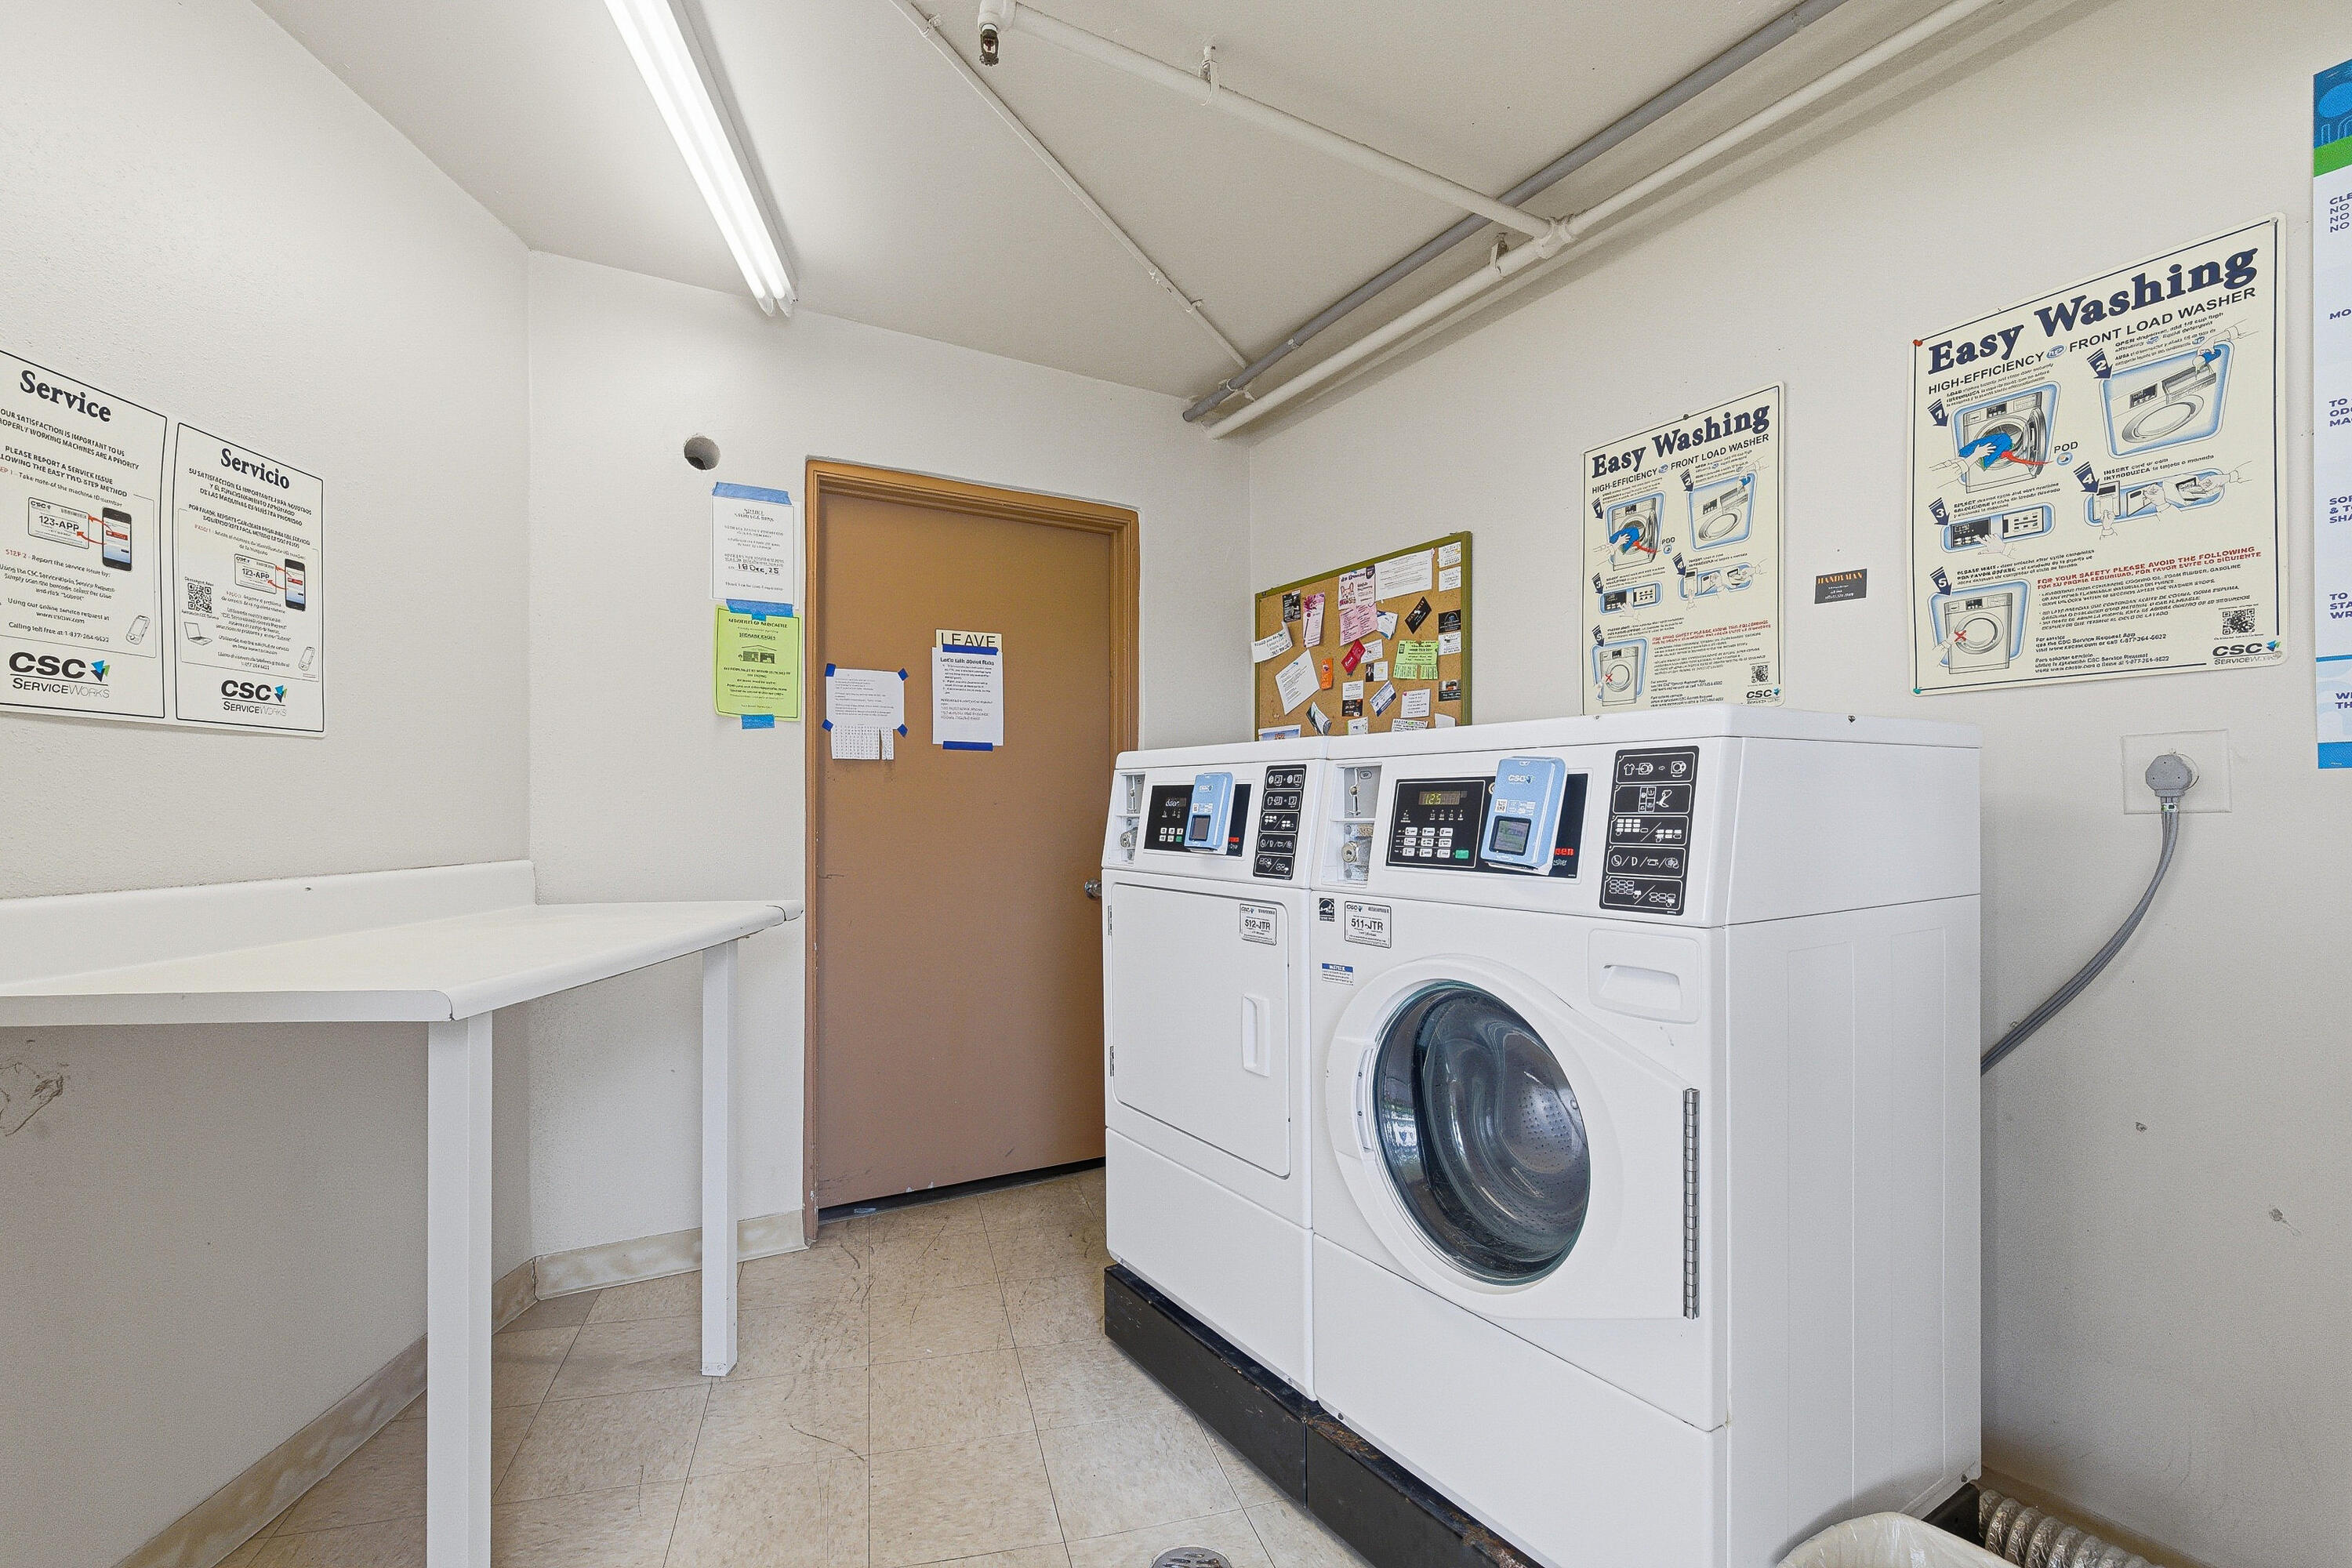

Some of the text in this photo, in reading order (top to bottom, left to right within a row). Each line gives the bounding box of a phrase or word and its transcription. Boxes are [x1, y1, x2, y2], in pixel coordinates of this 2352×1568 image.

[2330, 204, 2349, 213] NO
[2330, 213, 2349, 223] NO
[2330, 222, 2349, 232] NO
[1928, 248, 2258, 374] Easy Washing
[1929, 288, 2256, 394] HIGH-EFFICIENCY FRONT LOAD WASHER
[20, 370, 111, 422] Service
[2329, 398, 2347, 407] TO
[2329, 417, 2352, 426] MA
[0, 418, 28, 433] ROPERLY
[30, 428, 61, 444] WORKING
[63, 440, 94, 456] MACHINES
[17, 415, 64, 435] SATISFACTION
[71, 434, 107, 450] IMPORTANT
[1592, 447, 1646, 478] Easy
[1652, 405, 1769, 458] Washing
[2054, 441, 2078, 454] POD
[5, 446, 31, 459] PLEASE
[33, 455, 60, 467] REPORT
[33, 463, 46, 473] THE
[48, 468, 64, 478] EASY
[220, 448, 290, 489] Servicio
[1592, 468, 1657, 494] HIGH-EFFICIENCY
[1671, 456, 1700, 470] FRONT
[1701, 447, 1726, 461] LOAD
[1729, 434, 1769, 452] WASHER
[2083, 474, 2093, 484] 4
[1936, 509, 1945, 517] 3
[39, 516, 79, 532] 123-APP
[31, 555, 53, 565] Report
[2079, 569, 2111, 578] SAFETY
[2113, 563, 2145, 572] PLEASE
[2149, 559, 2175, 568] AVOID
[2199, 546, 2255, 560] FOLLOWING
[9, 622, 31, 631] Calling
[942, 633, 996, 647] LEAVE
[2212, 643, 2262, 656] CSC
[9, 652, 86, 679] CSC
[221, 680, 271, 701] CSC
[1746, 689, 1772, 699] CSC
[1245, 920, 1270, 930] 512-JTR
[1351, 918, 1383, 931] 511-JTR
